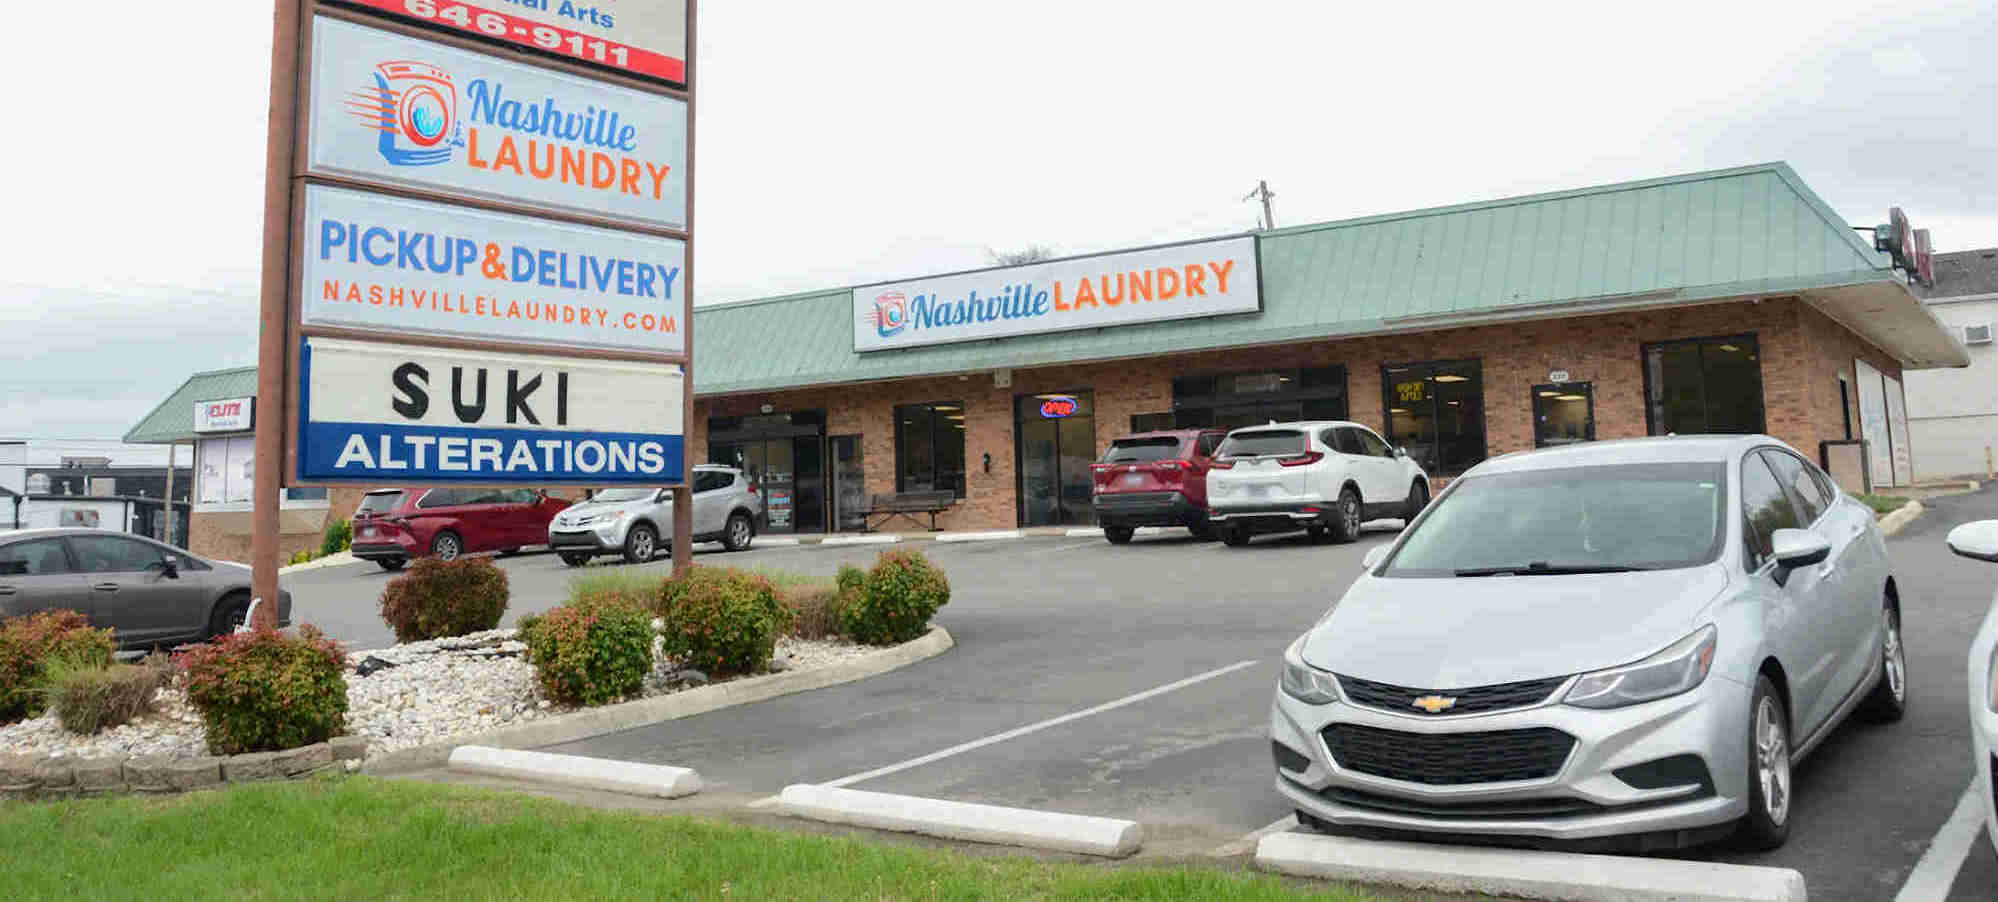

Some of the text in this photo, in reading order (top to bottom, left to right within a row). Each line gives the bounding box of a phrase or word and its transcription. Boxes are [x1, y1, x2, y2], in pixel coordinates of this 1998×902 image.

[403, 0, 629, 66] 646-9111
[558, 0, 614, 28] Arts
[466, 78, 637, 152] Nashville
[466, 127, 672, 201] LAUNDRY
[322, 279, 678, 334] NASHVILLELAUNDRY.COM
[911, 259, 1235, 329] Nashville LAUNDRY
[391, 361, 569, 426] SUKI
[1044, 401, 1073, 416] OPEN
[333, 433, 666, 474] ALTERATIONS
